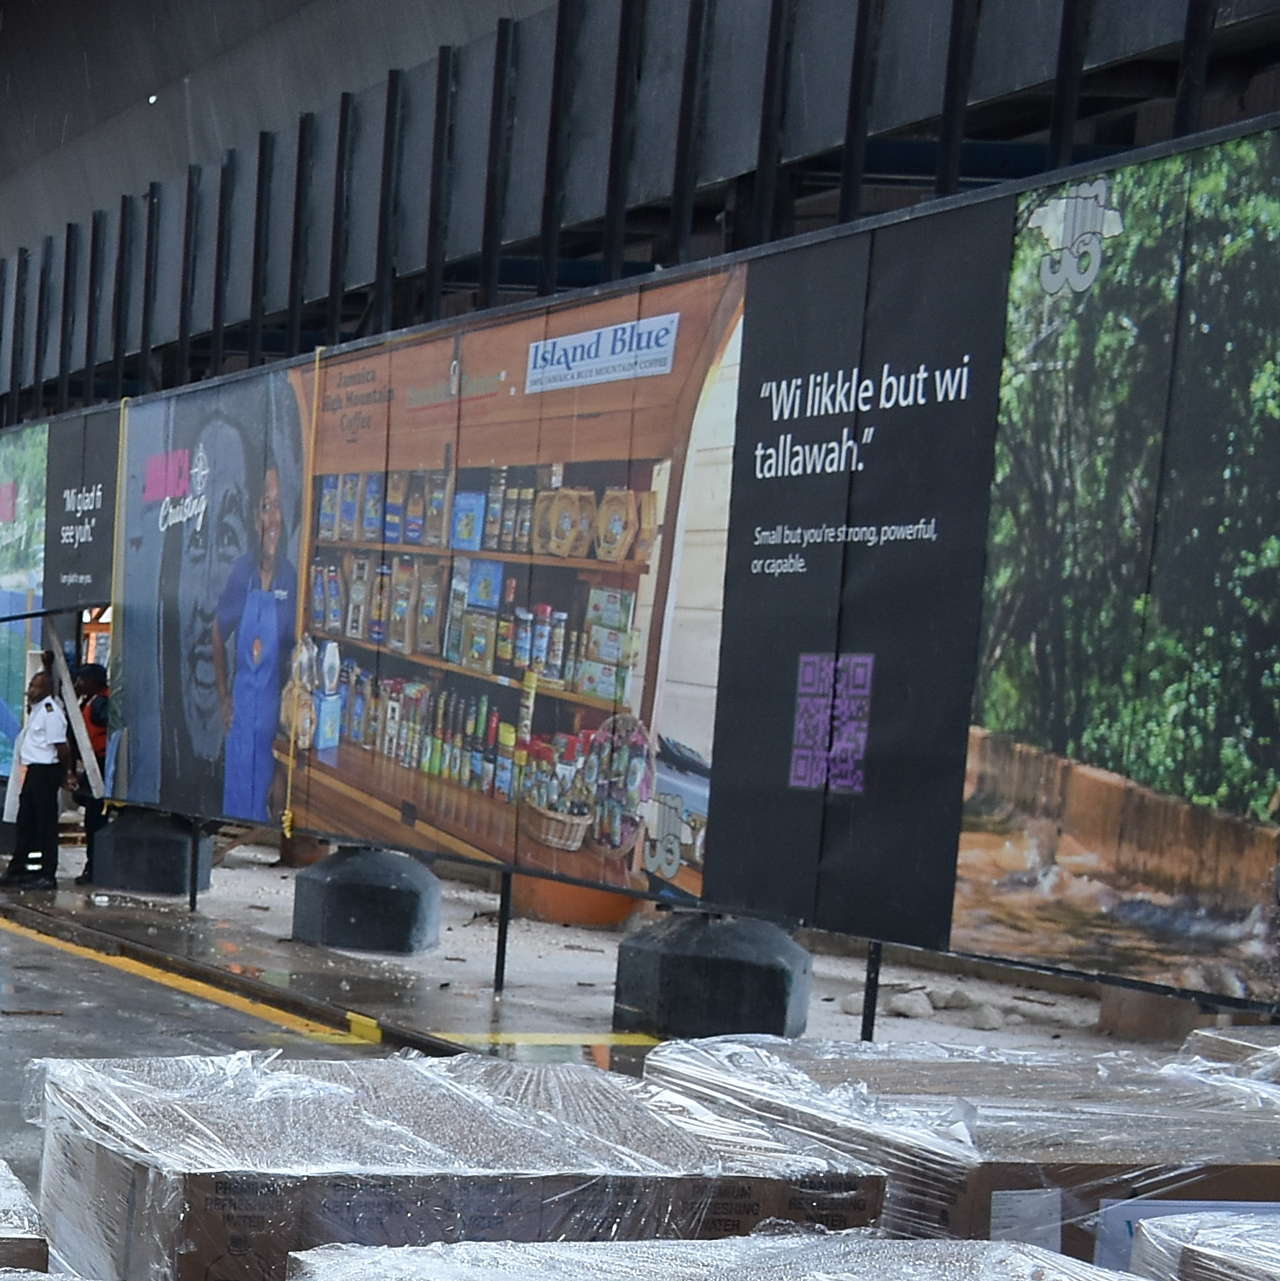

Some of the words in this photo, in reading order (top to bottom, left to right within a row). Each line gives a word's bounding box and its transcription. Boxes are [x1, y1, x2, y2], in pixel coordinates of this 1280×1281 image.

[532, 331, 602, 372] Island
[610, 324, 671, 357] Blue
[806, 367, 874, 418] likkle
[879, 363, 929, 409] but
[934, 354, 971, 402] wi
[77, 483, 95, 517] glad
[60, 524, 74, 544] see
[753, 524, 783, 546] Small
[784, 525, 801, 544] but
[880, 517, 938, 547] powerful,
[751, 558, 763, 574] or
[764, 553, 808, 577] capable.
